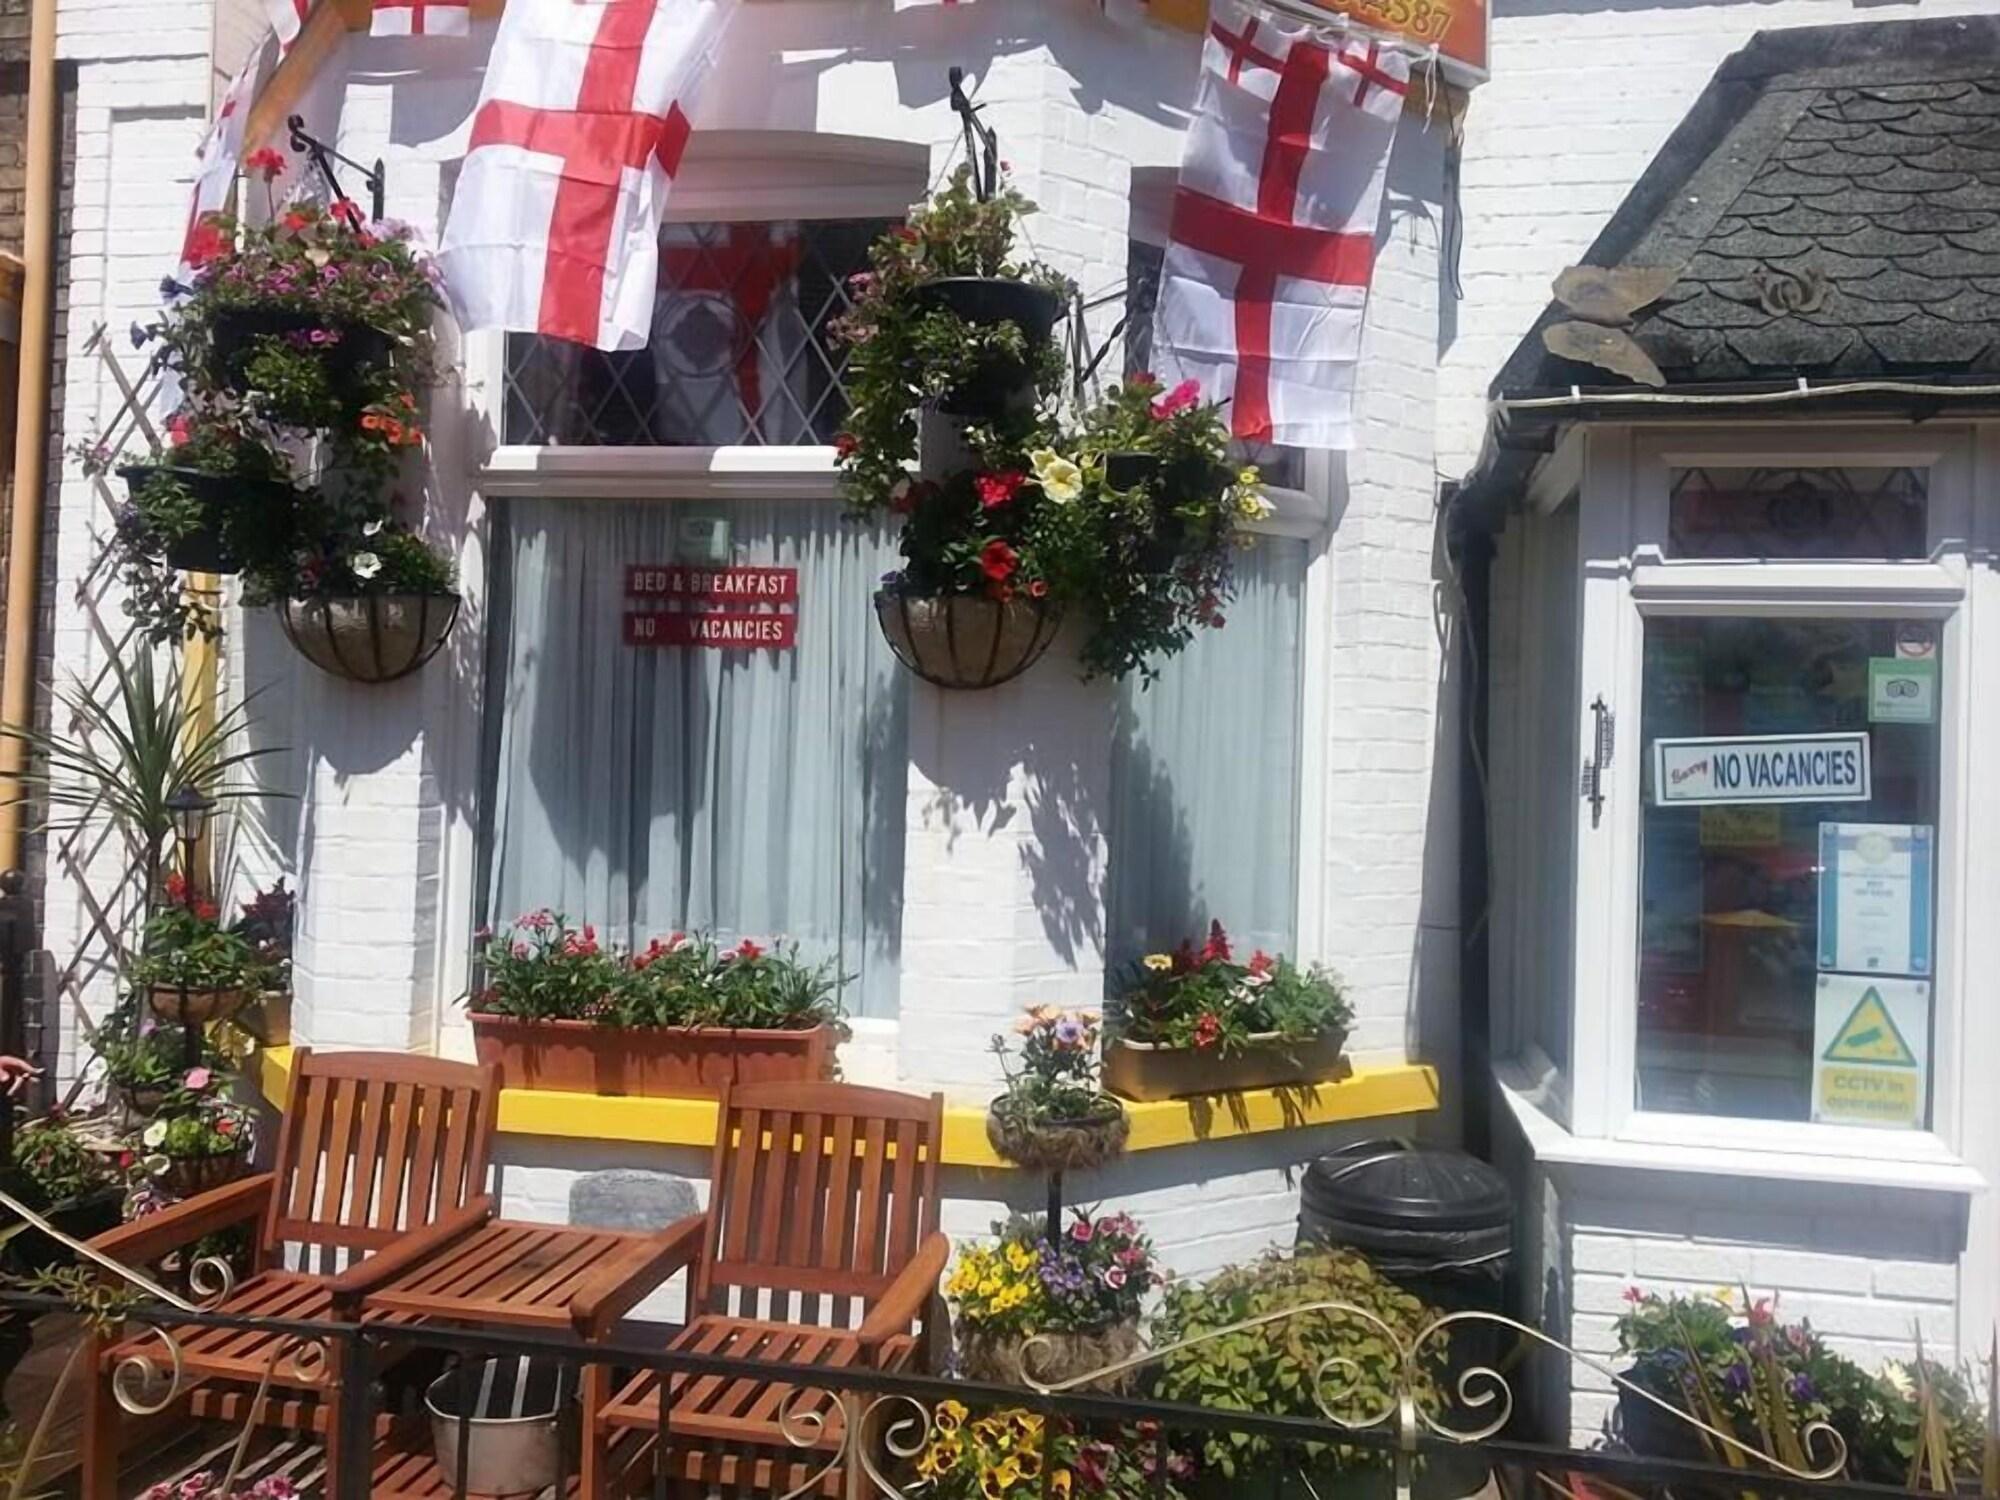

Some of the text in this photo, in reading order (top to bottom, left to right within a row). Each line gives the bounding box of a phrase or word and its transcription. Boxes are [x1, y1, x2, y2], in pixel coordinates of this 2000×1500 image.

[634, 572, 788, 595] BED & BREAKFAST
[634, 617, 783, 641] NO VACANCIES
[1713, 752, 1741, 789] NO
[1746, 749, 1857, 788] VACANCIES
[1834, 1074, 1884, 1091] CCTV
